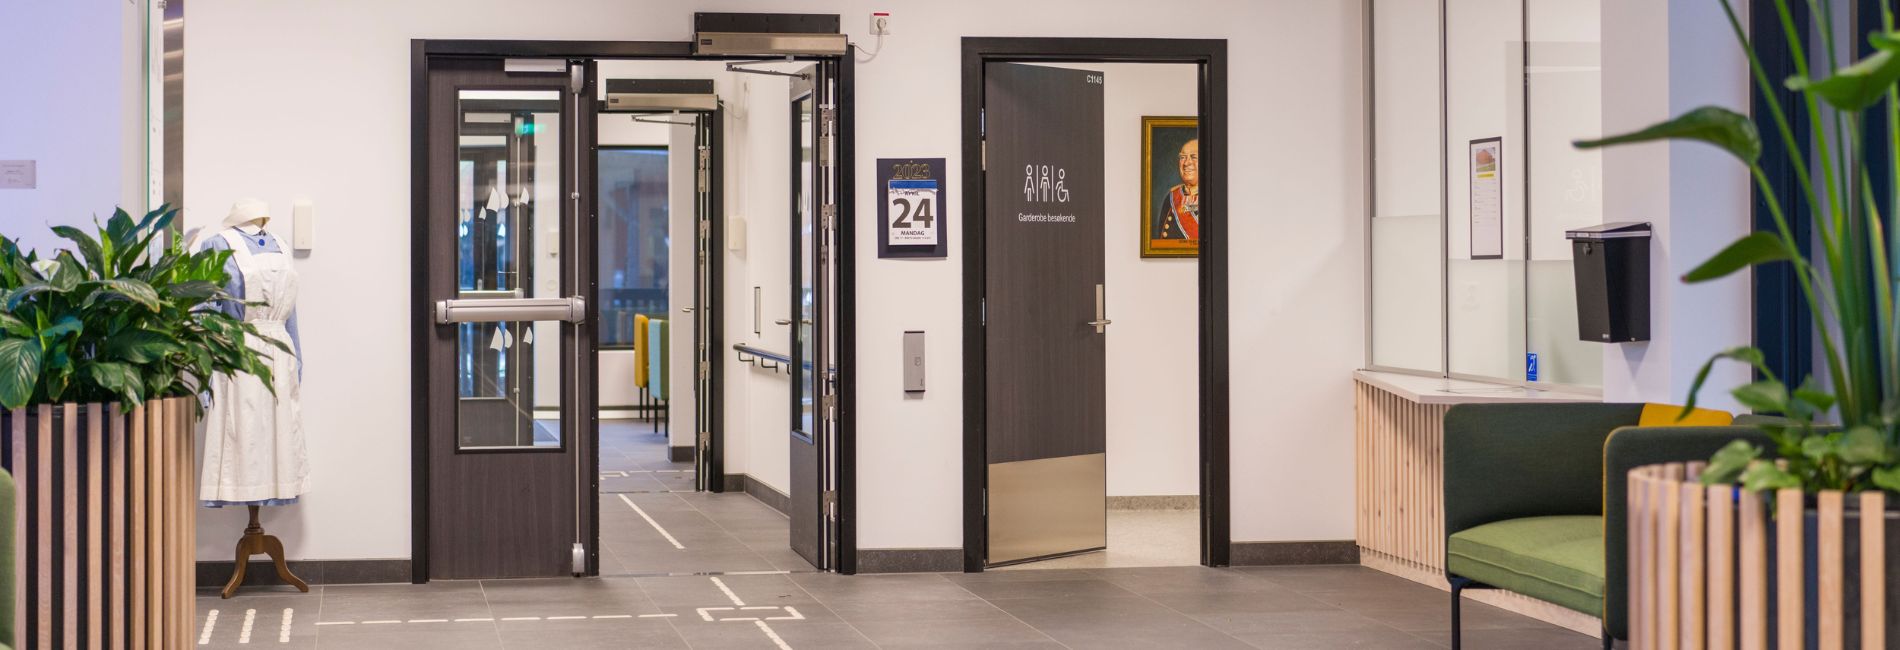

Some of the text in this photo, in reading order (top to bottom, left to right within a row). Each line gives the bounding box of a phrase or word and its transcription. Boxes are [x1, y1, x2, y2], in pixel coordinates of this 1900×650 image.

[1087, 74, 1103, 85] C1145
[892, 163, 931, 180] 2023
[892, 198, 934, 229] 24
[1018, 212, 1076, 223] Garderobe besøkende
